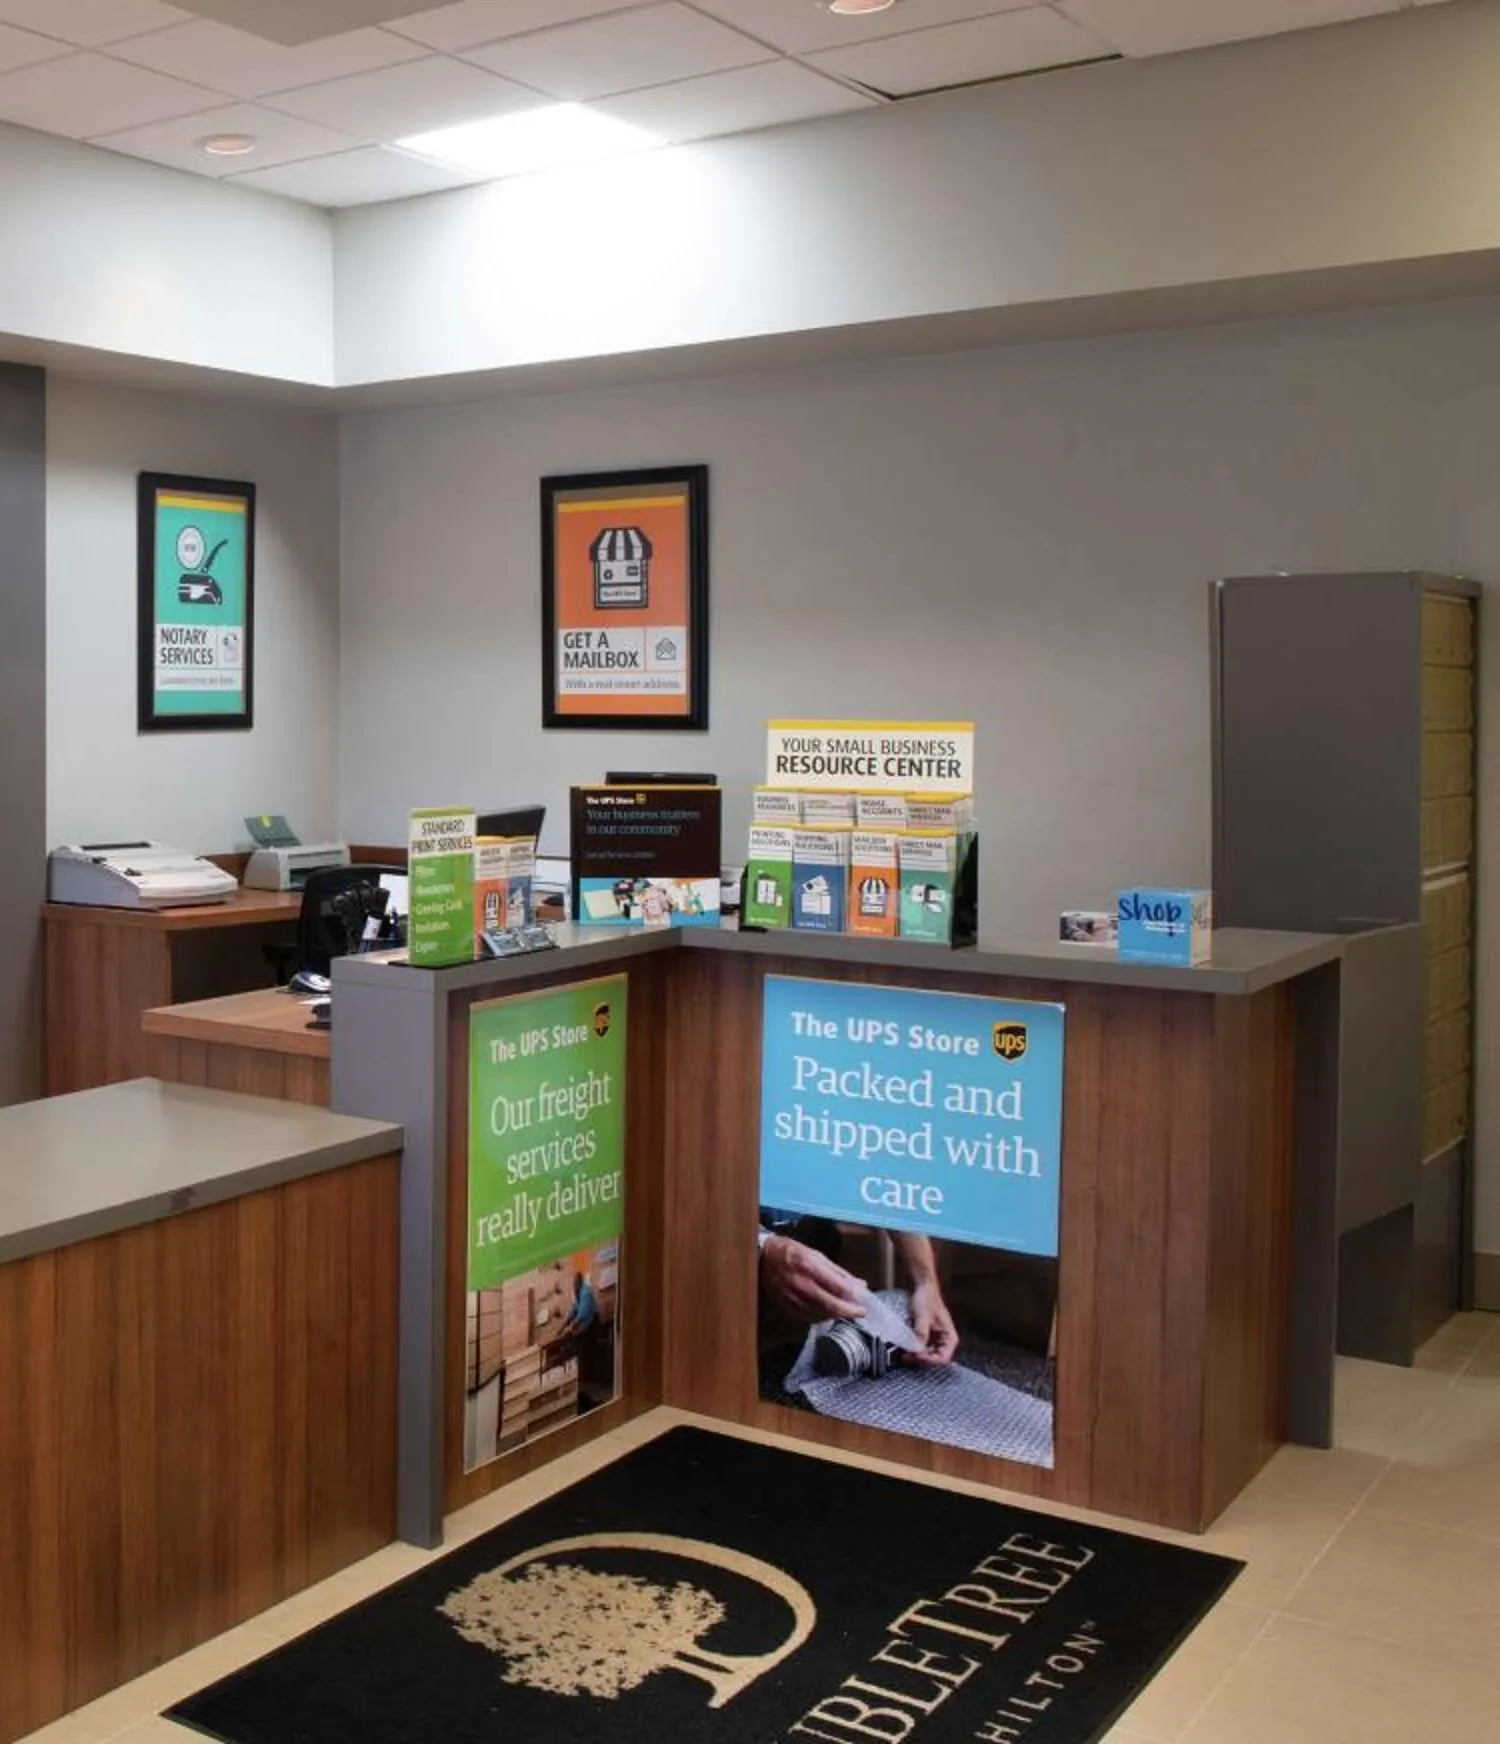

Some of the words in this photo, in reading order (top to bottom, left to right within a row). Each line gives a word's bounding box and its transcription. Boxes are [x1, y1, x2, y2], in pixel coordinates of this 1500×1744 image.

[160, 627, 207, 644] NOTARY
[563, 632, 592, 649] GET
[598, 632, 609, 649] A
[160, 648, 213, 665] SERVICES
[563, 652, 639, 669] MAILBOX
[782, 738, 821, 752] YOUR
[827, 739, 875, 754] SMALL
[881, 740, 956, 756] BUSINESS
[776, 756, 876, 775] RESOURCE
[884, 759, 961, 778] CENTER
[422, 819, 464, 835] STANDARD
[490, 1040, 516, 1064] The
[520, 1028, 548, 1056] UPS
[552, 1023, 588, 1049] Store
[790, 1011, 837, 1039] The
[847, 1018, 899, 1046] UPS
[908, 1025, 980, 1056] Store
[995, 1032, 1025, 1055] ups
[490, 1095, 534, 1136] Our
[538, 1070, 611, 1123] freight
[793, 1055, 933, 1108] Packed
[944, 1080, 1022, 1121] and
[775, 1104, 933, 1160] shipped
[944, 1133, 1042, 1177] with
[507, 1129, 596, 1184] services
[476, 1191, 543, 1248] really
[547, 1169, 621, 1222] deliver
[860, 1175, 944, 1214] care
